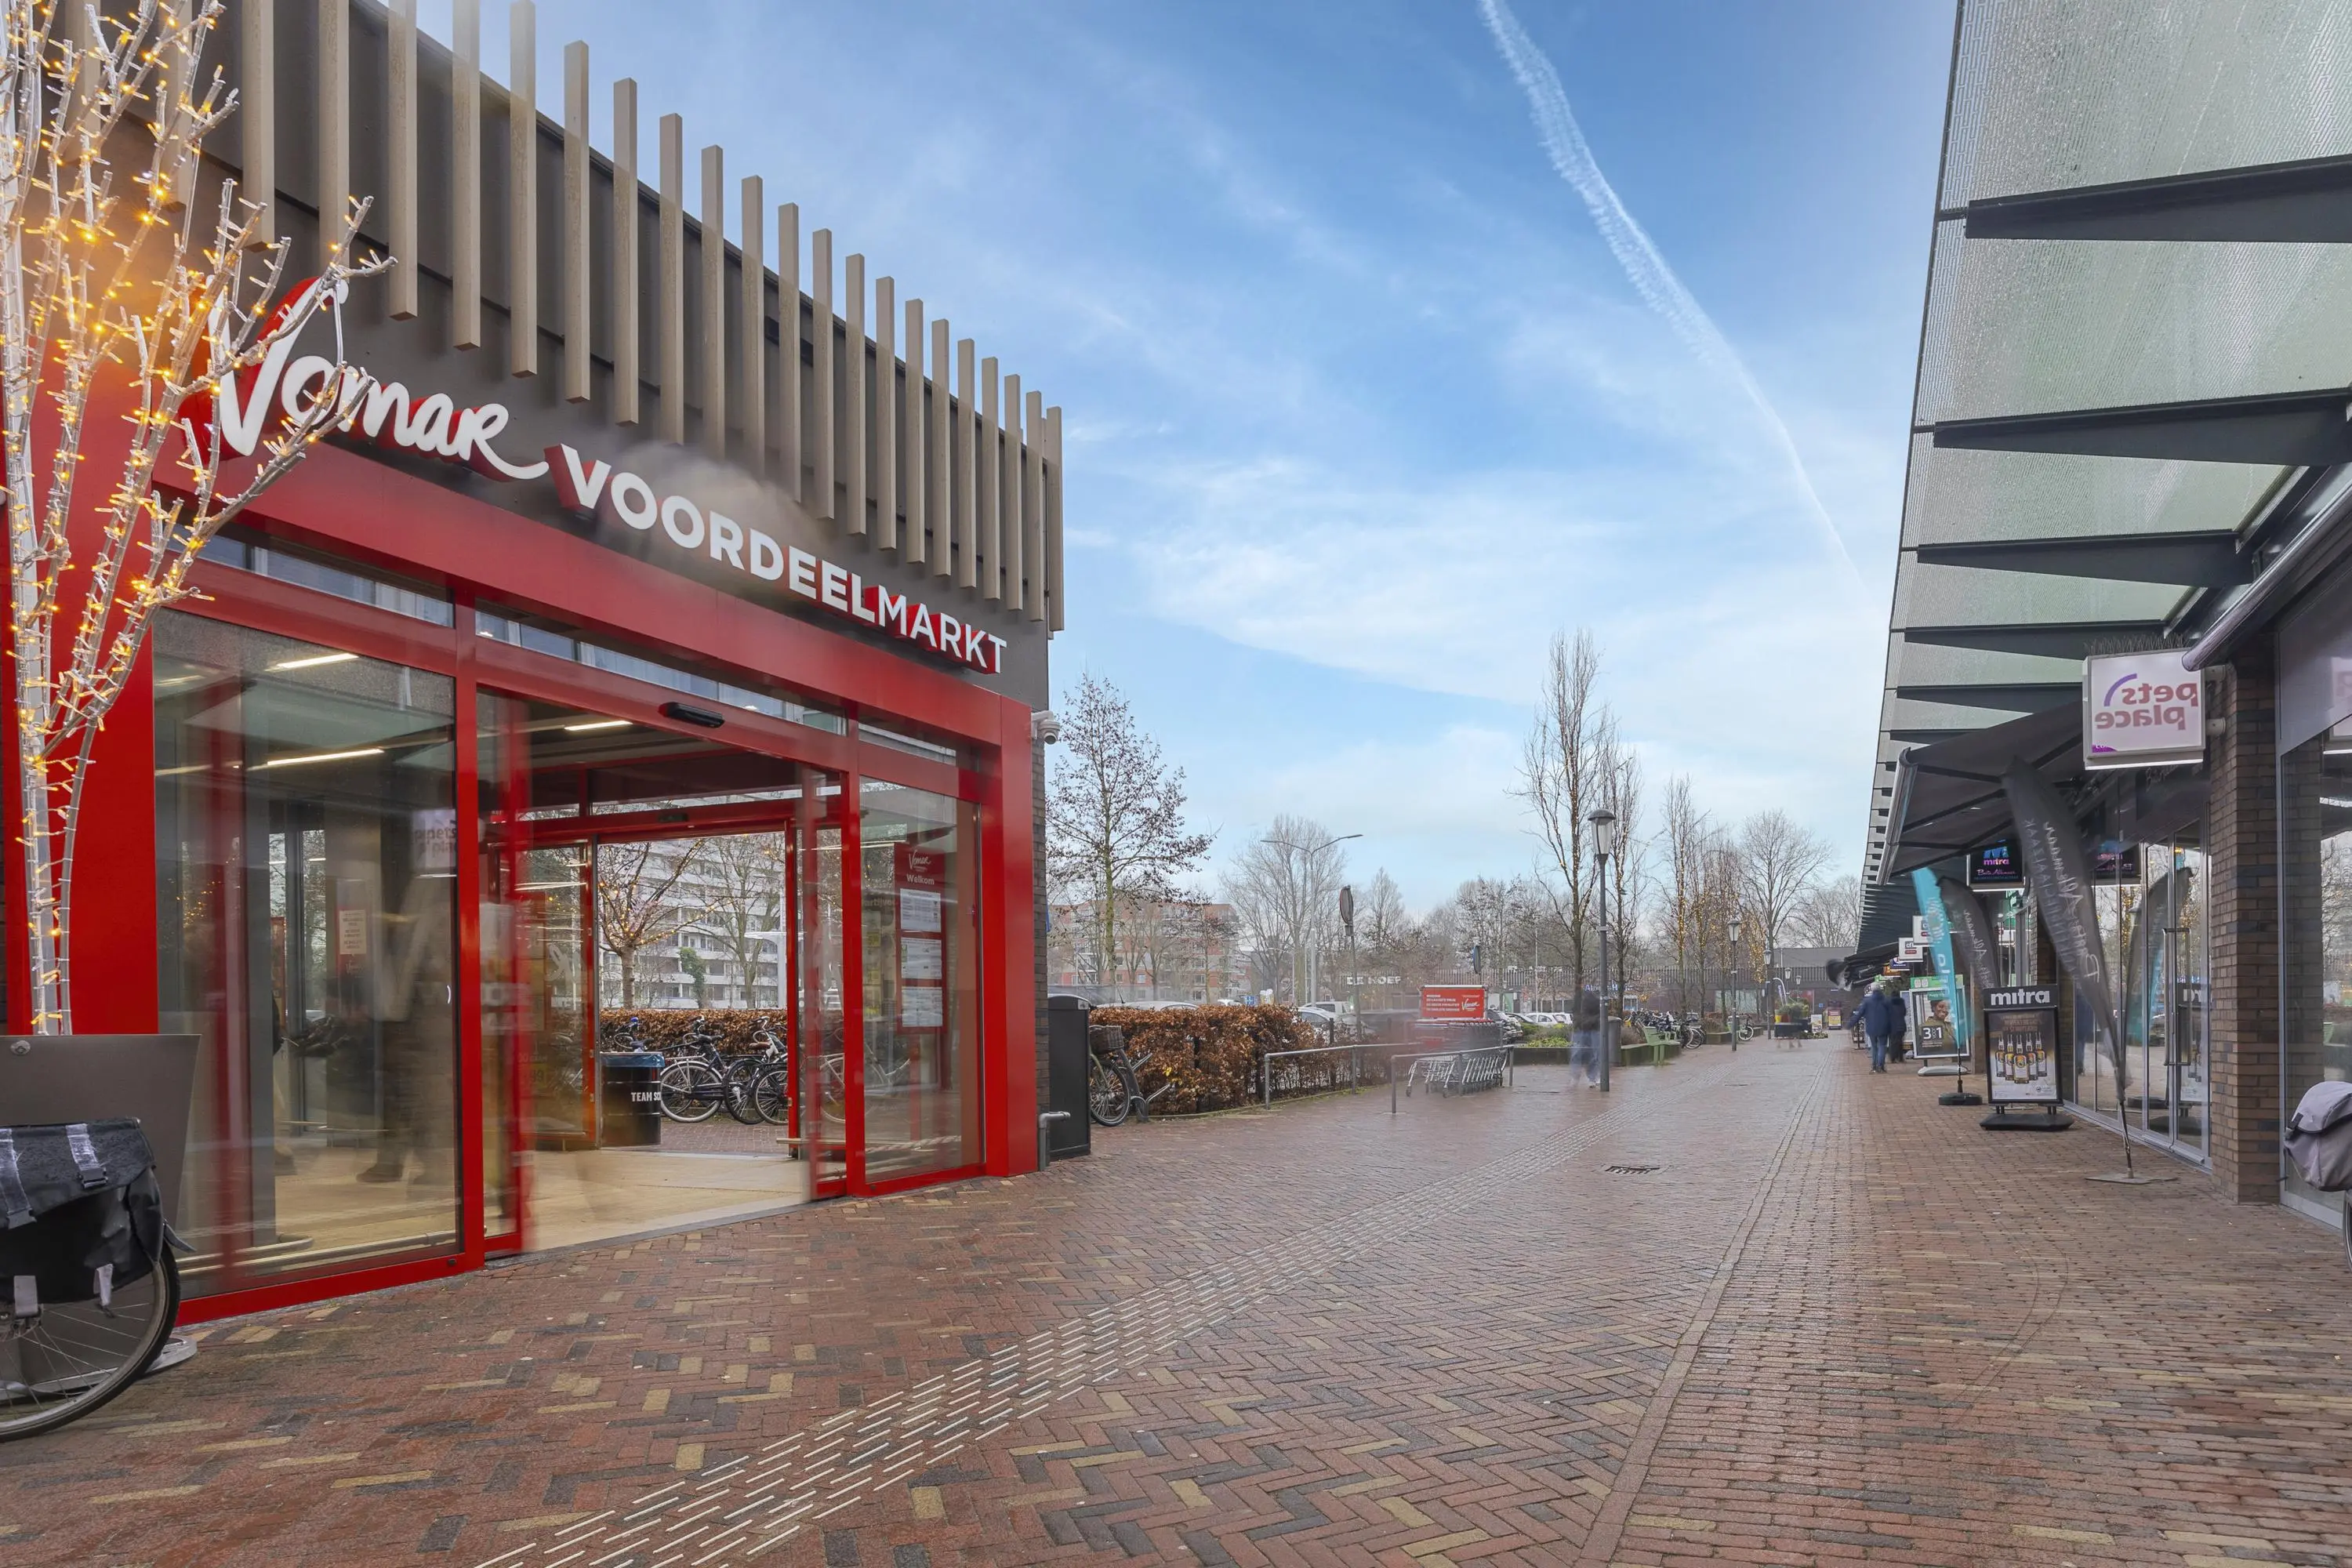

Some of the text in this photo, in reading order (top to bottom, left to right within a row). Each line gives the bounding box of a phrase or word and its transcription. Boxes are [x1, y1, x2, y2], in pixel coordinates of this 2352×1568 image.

[206, 275, 1007, 674] Vomar VOORDEELMARKT
[906, 873, 935, 884] Welkom
[1991, 989, 2050, 1005] mitra
[1923, 1028, 1931, 1040] 3
[1936, 1027, 1942, 1039] 1
[630, 1092, 652, 1102] TEAM
